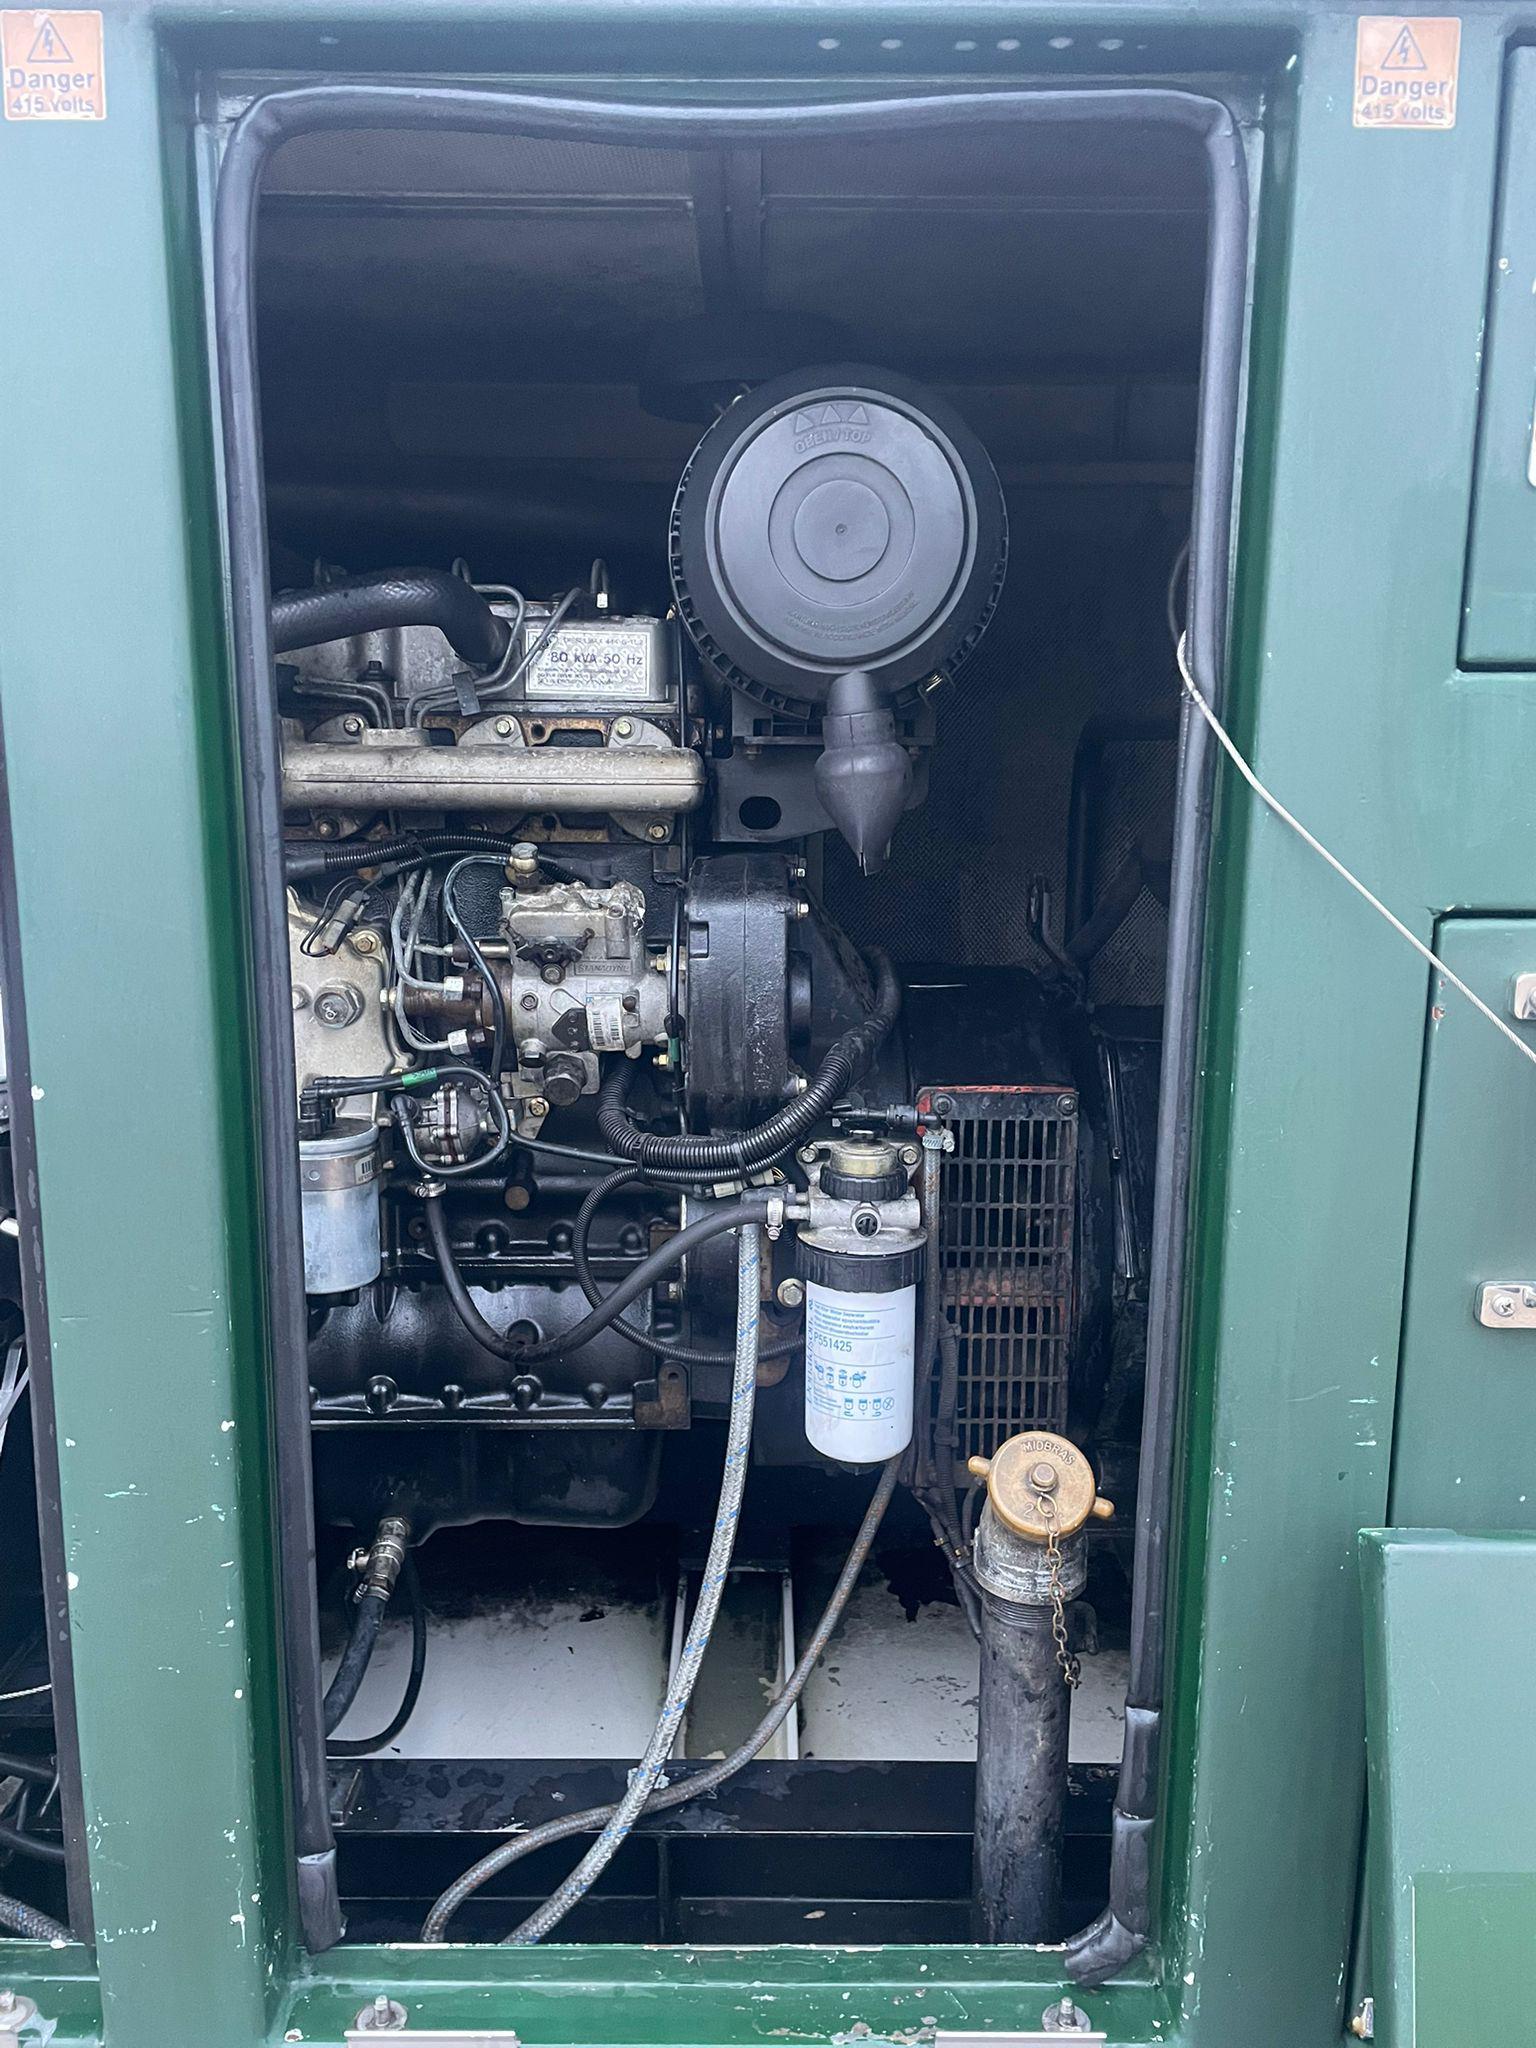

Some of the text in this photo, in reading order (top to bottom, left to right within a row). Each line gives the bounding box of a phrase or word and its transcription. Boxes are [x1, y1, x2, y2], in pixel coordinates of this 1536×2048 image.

[9, 68, 95, 93] Danger
[1361, 75, 1448, 101] Danger
[13, 96, 95, 113] 415 volts
[1400, 103, 1446, 120] volts
[550, 651, 644, 666] 80 kVA 50 Hz
[813, 1331, 853, 1352] P551425
